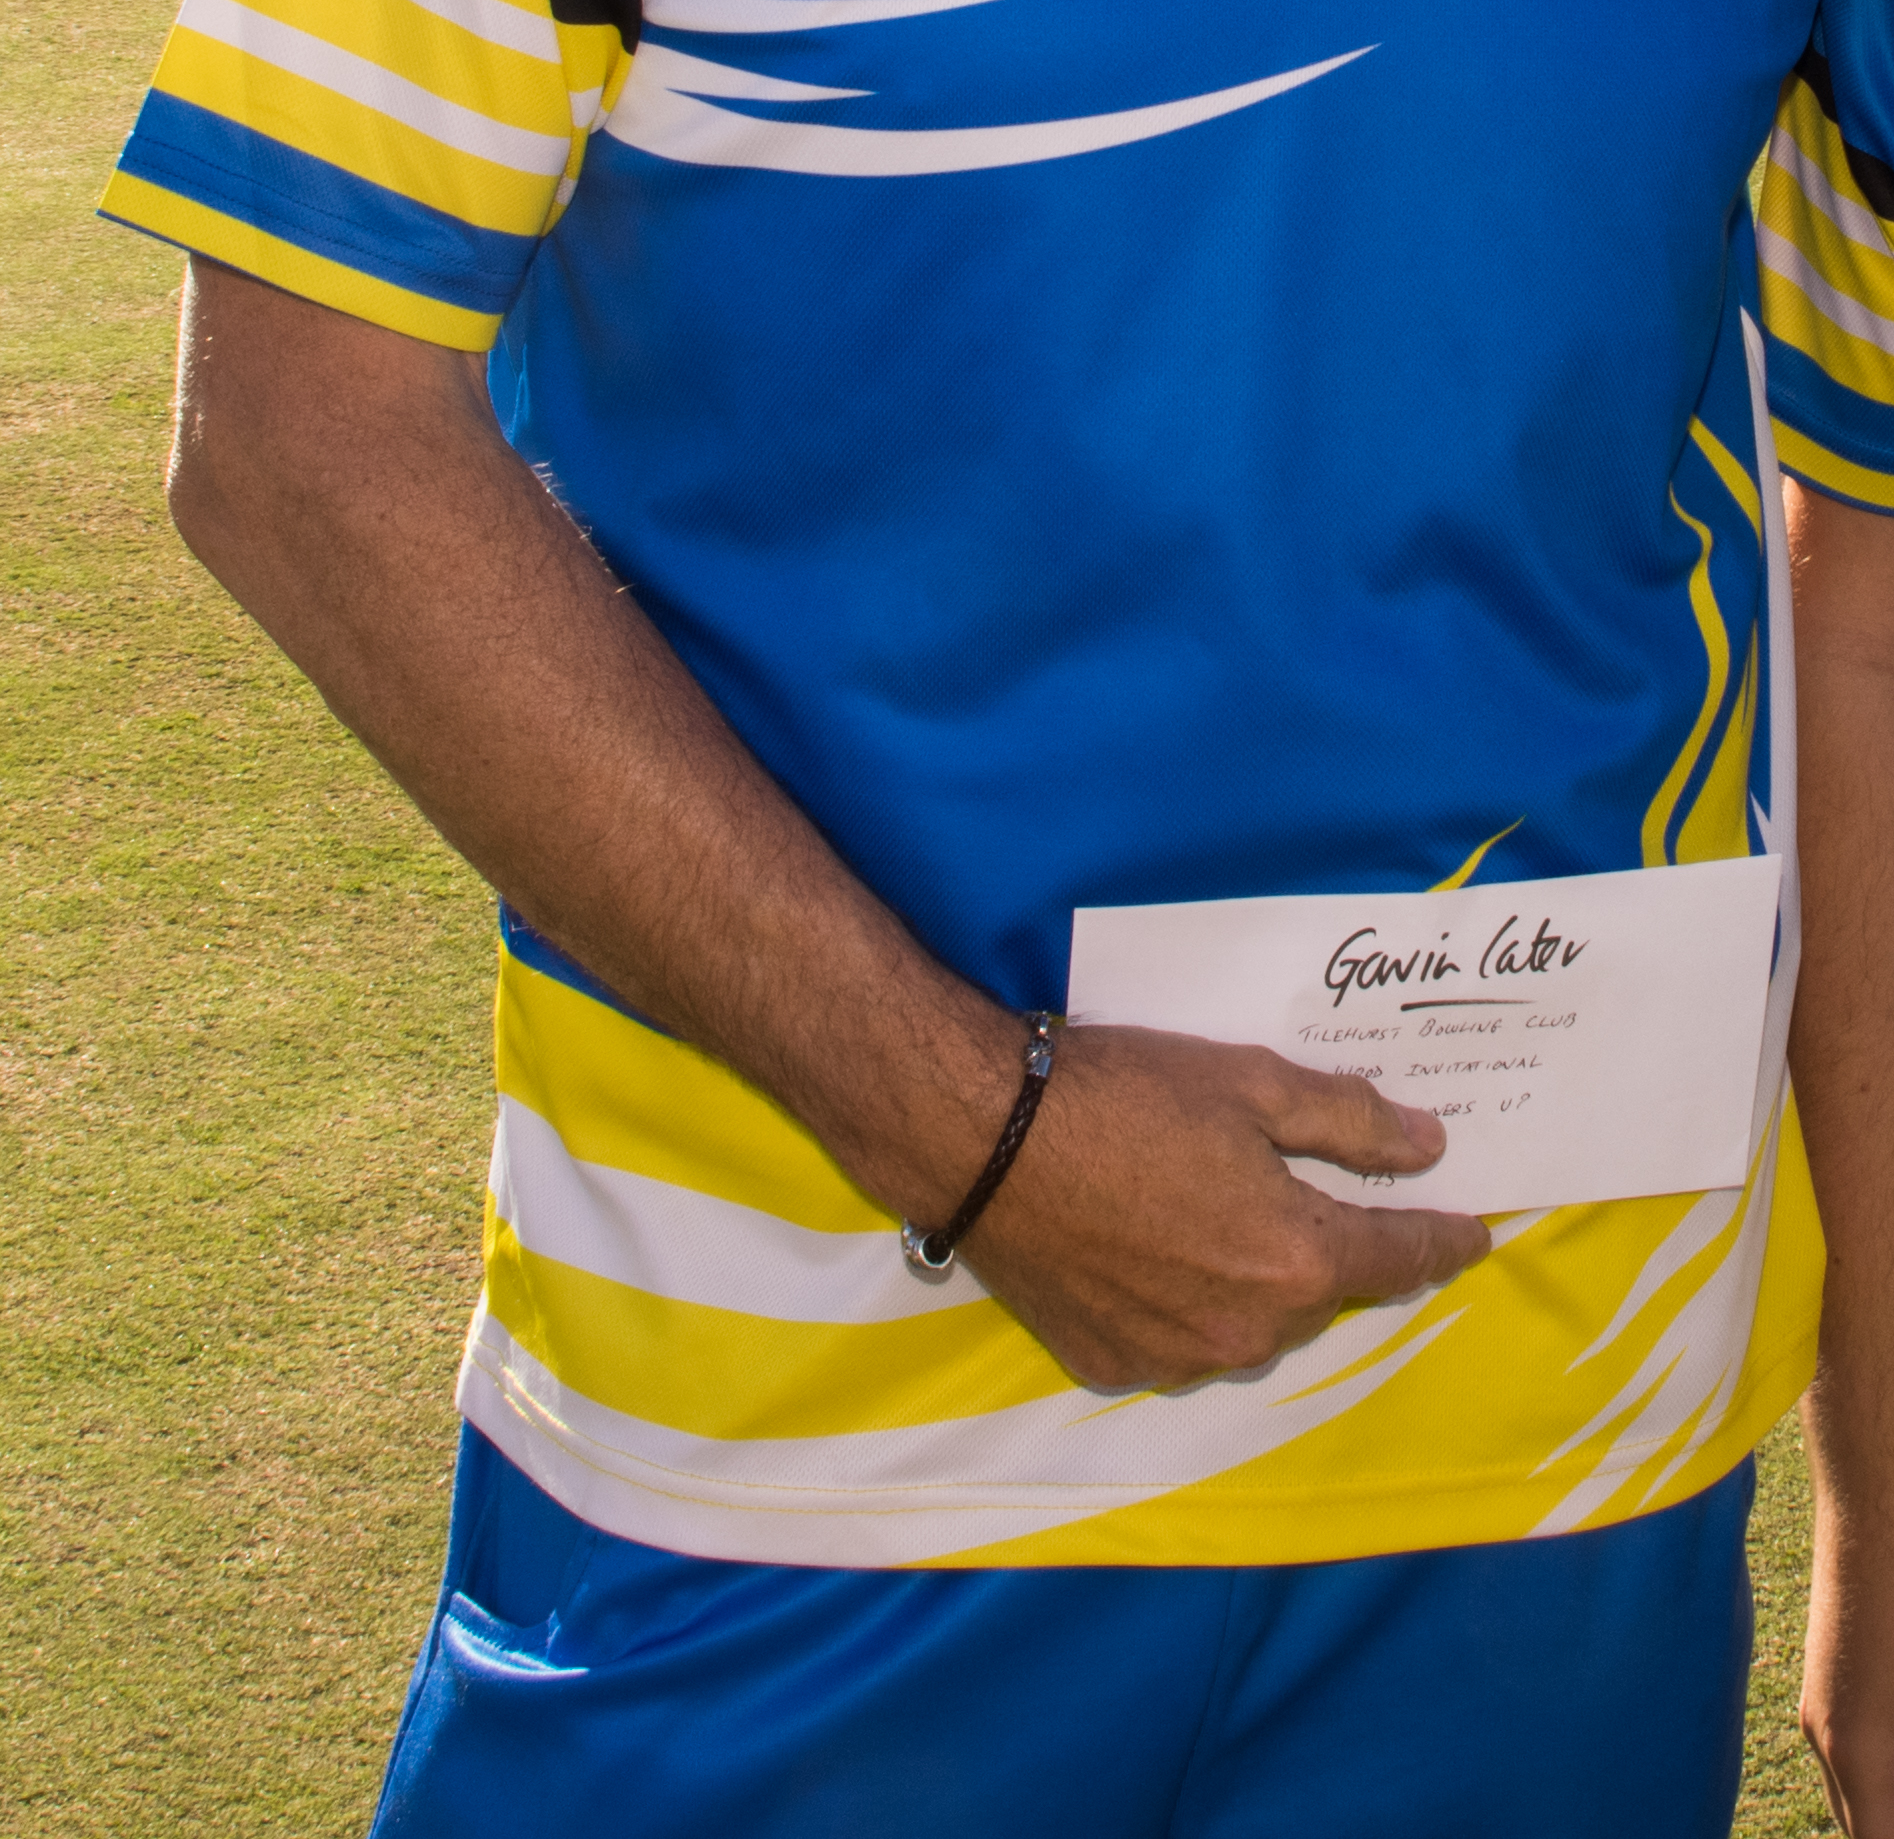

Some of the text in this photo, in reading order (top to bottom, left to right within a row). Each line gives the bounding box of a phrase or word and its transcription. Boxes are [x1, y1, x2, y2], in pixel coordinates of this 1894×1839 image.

[1325, 927, 1461, 1008] Gavin
[1298, 1012, 1577, 1043] TILEHURST BOWLING CLUB
[1404, 1054, 1543, 1077] INVITATIONAL
